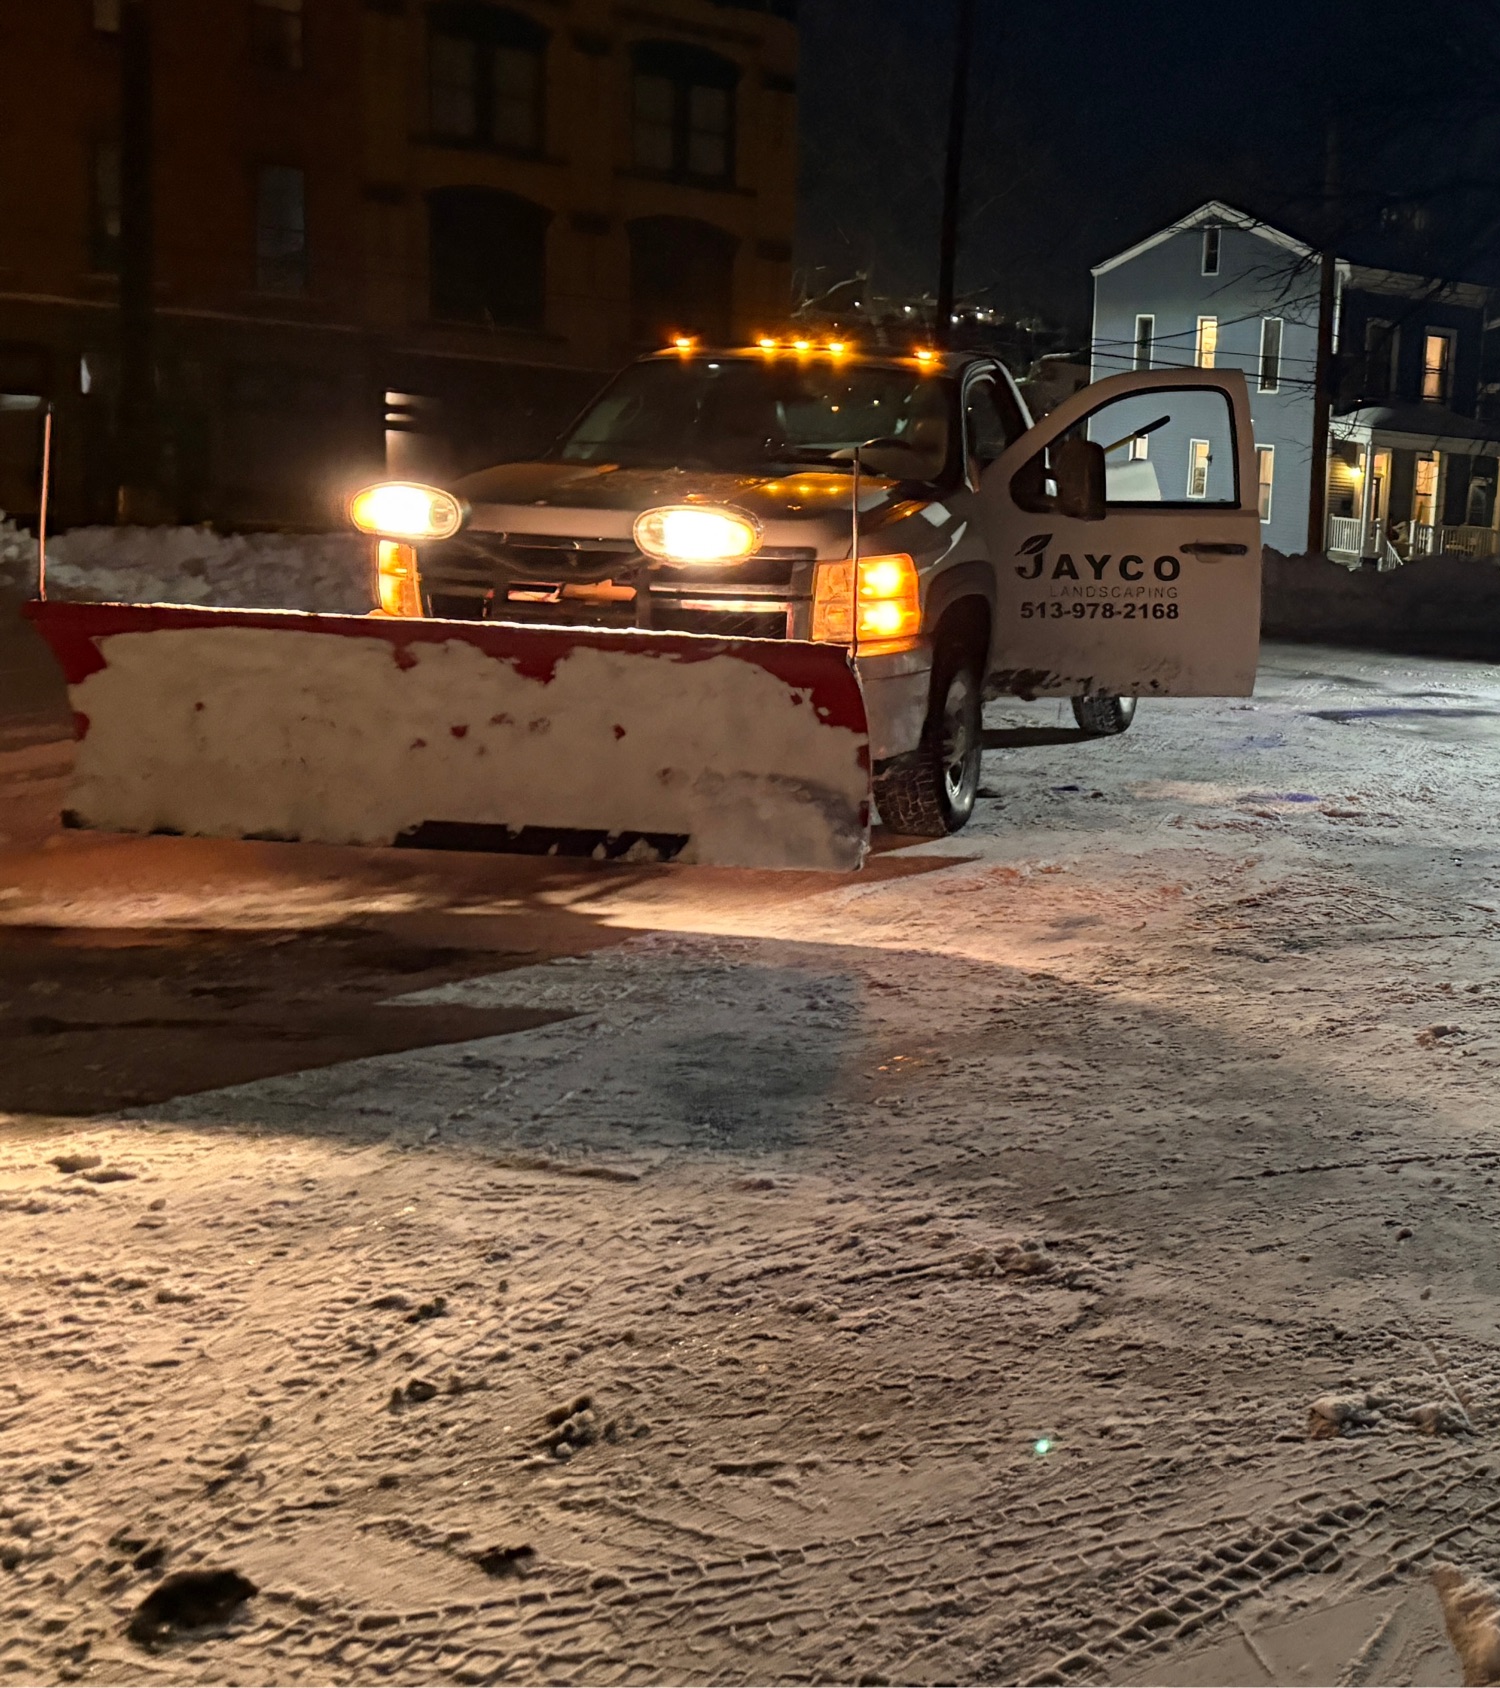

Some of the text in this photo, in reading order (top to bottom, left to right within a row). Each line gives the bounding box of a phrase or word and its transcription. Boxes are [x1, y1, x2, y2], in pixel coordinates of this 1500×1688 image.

[1015, 543, 1181, 581] JAYCO
[1050, 586, 1178, 599] LANDSCAPING
[1020, 602, 1179, 619] 513-978-2168
